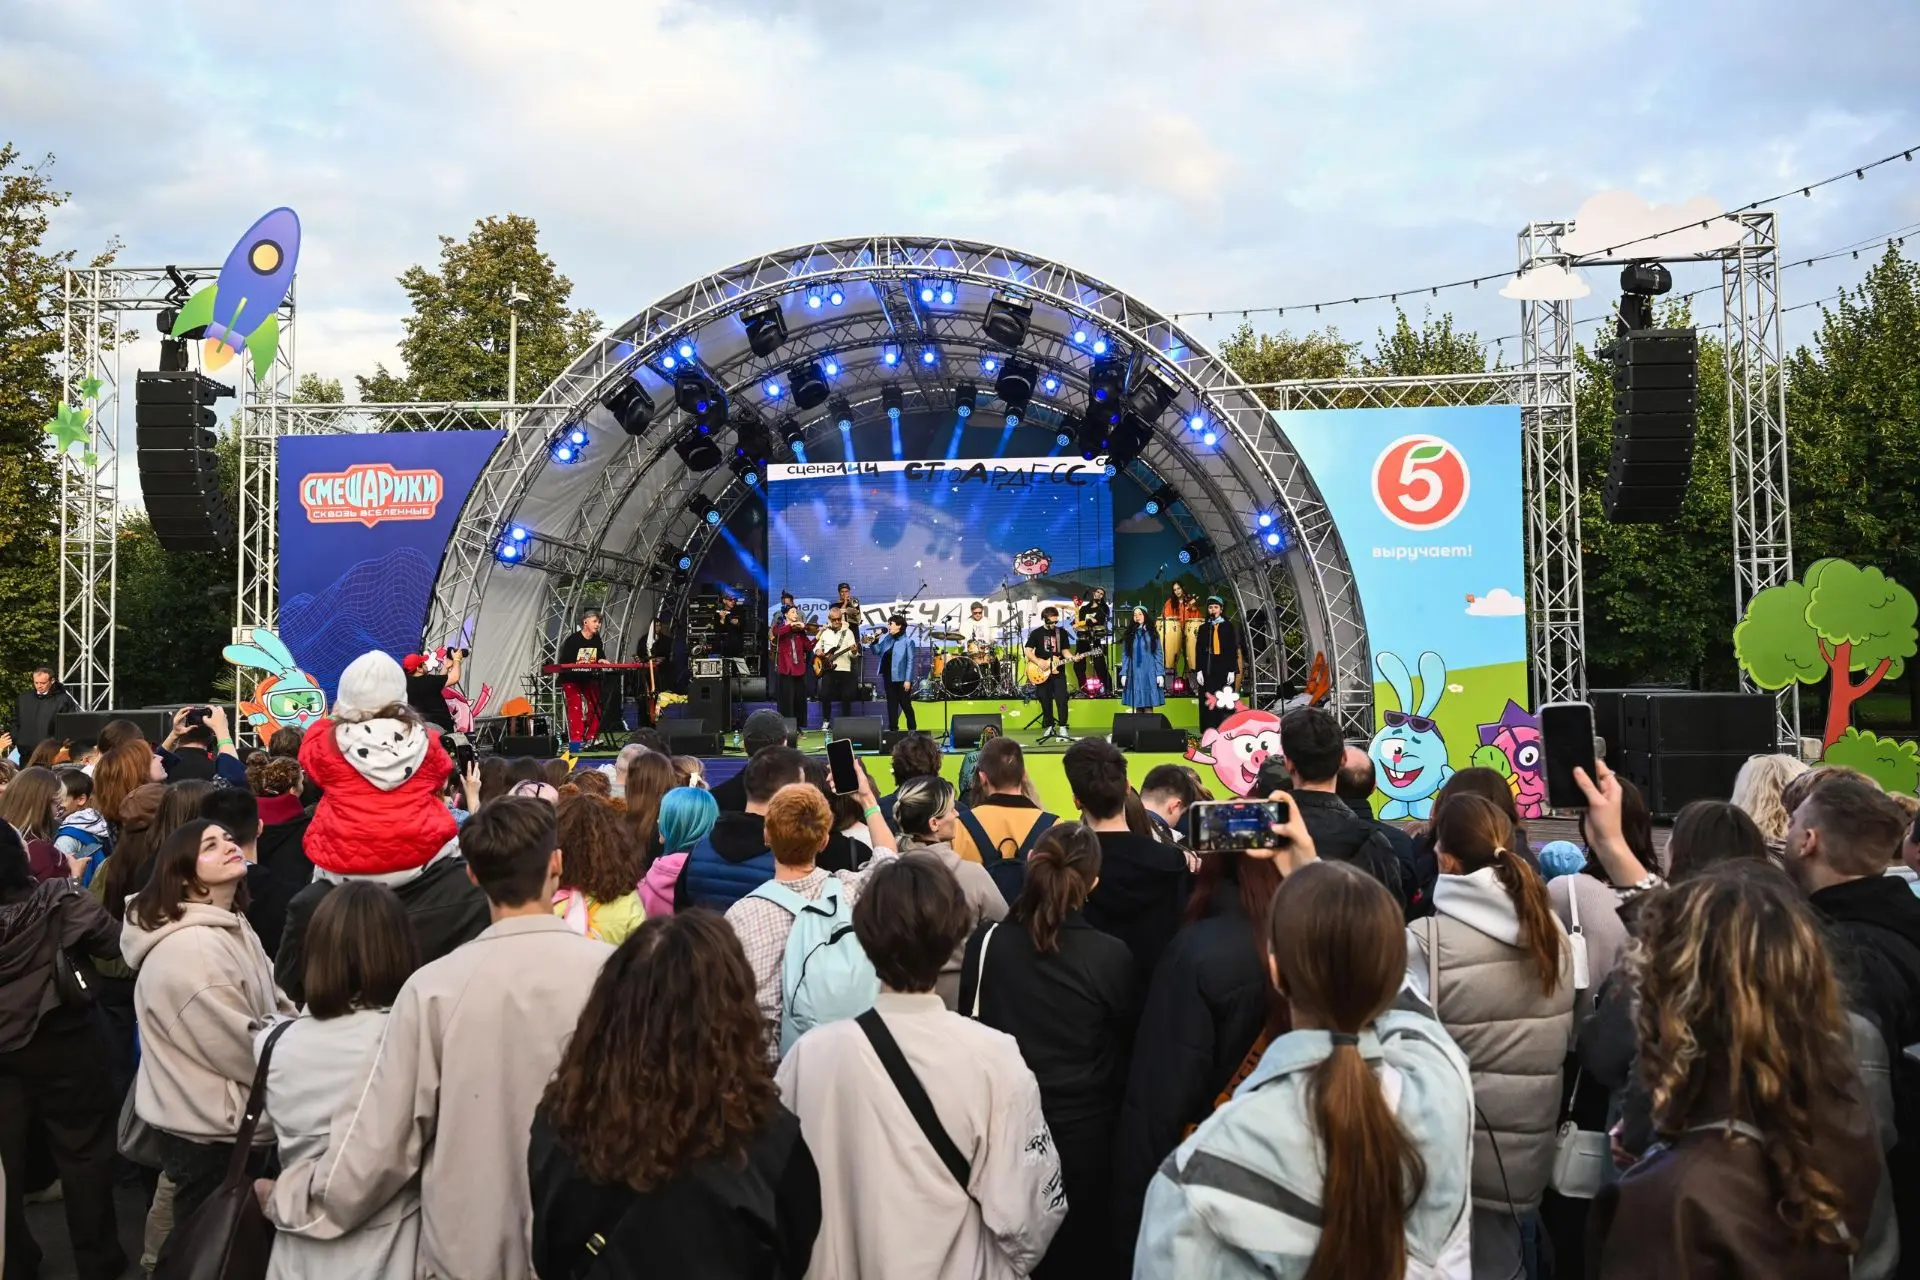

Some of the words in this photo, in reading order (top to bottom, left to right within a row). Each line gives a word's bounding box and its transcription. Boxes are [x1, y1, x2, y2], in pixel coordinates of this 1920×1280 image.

[304, 469, 437, 508] СМЕШАРИКИ
[313, 509, 357, 519] СКВОЗЬ
[360, 507, 430, 517] ВСЕЛЕННЫЕ
[1372, 544, 1473, 561] выручает!
